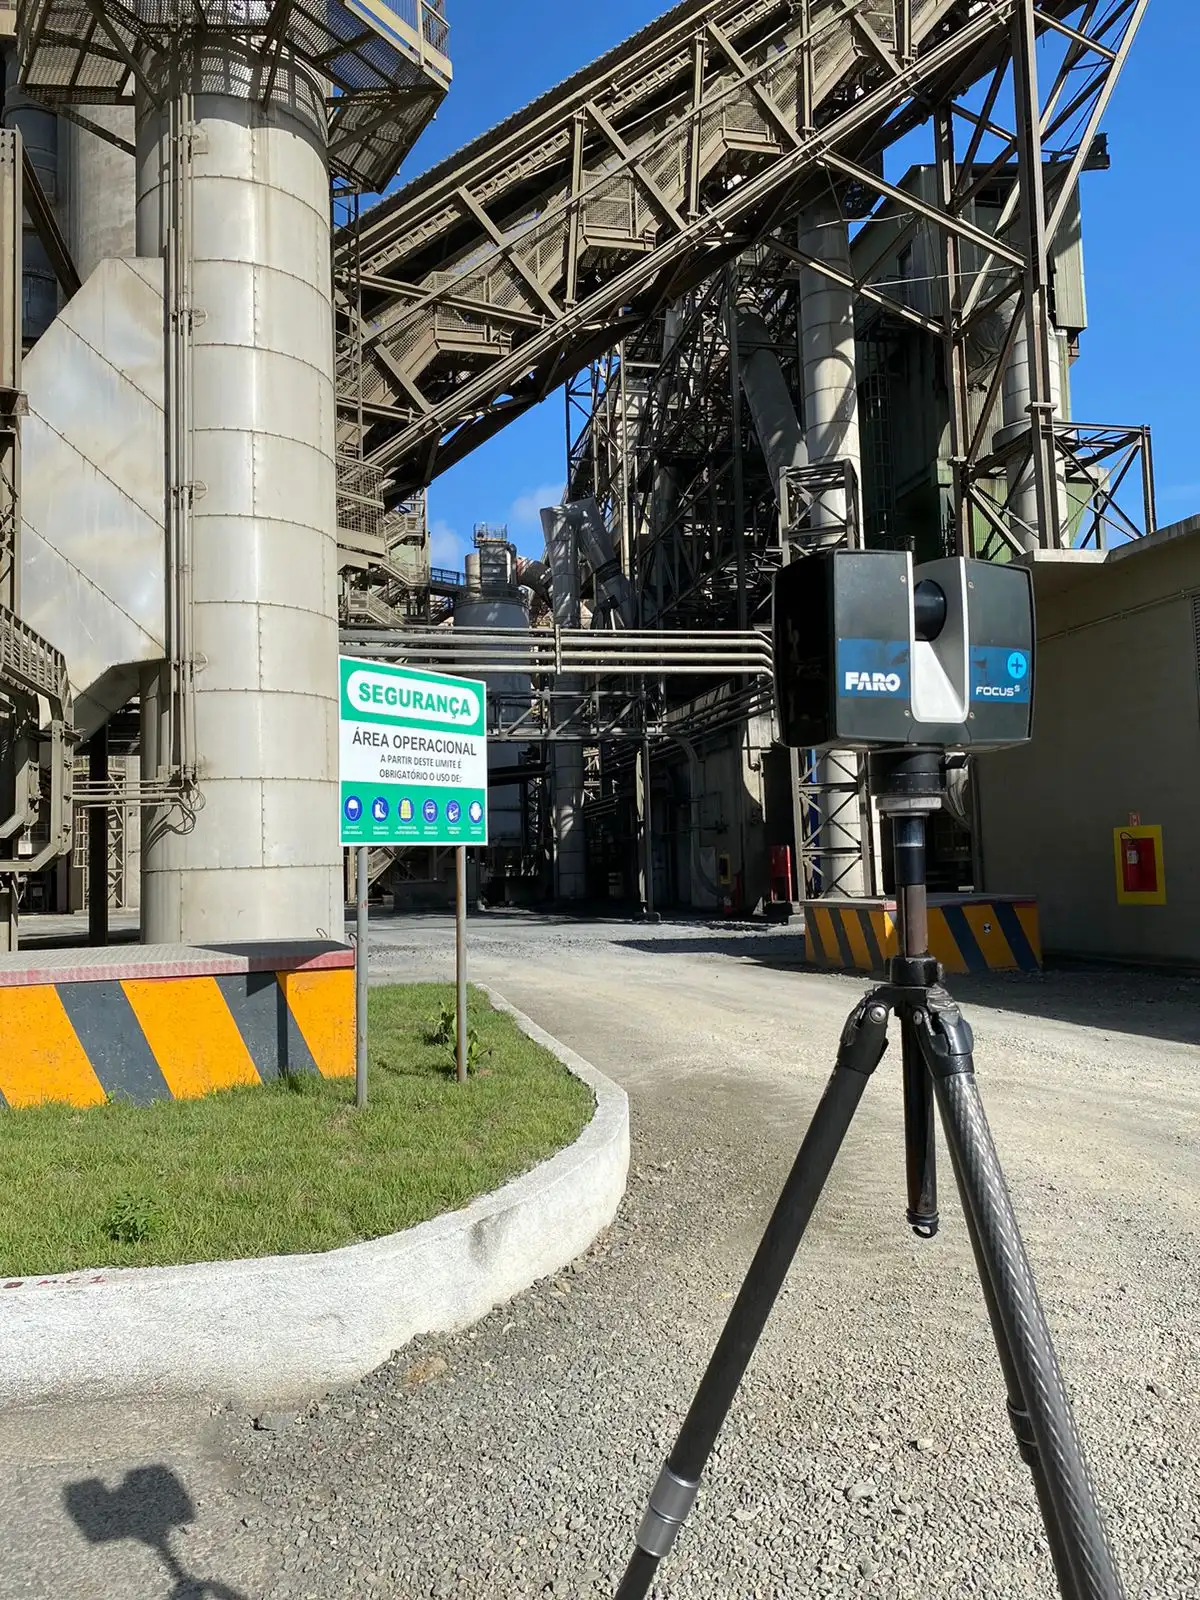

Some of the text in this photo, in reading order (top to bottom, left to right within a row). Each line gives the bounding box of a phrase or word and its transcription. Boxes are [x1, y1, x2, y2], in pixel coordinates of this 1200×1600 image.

[844, 671, 901, 692] FARO
[358, 682, 471, 719] SEGURANÇA
[352, 726, 477, 756] ÁREA OPERACIONAL
[380, 754, 463, 769] A PARTIR DESTE LIMITE É
[379, 768, 428, 780] OBRIGATÓRIO
[429, 772, 435, 780] O
[436, 773, 450, 782] USO
